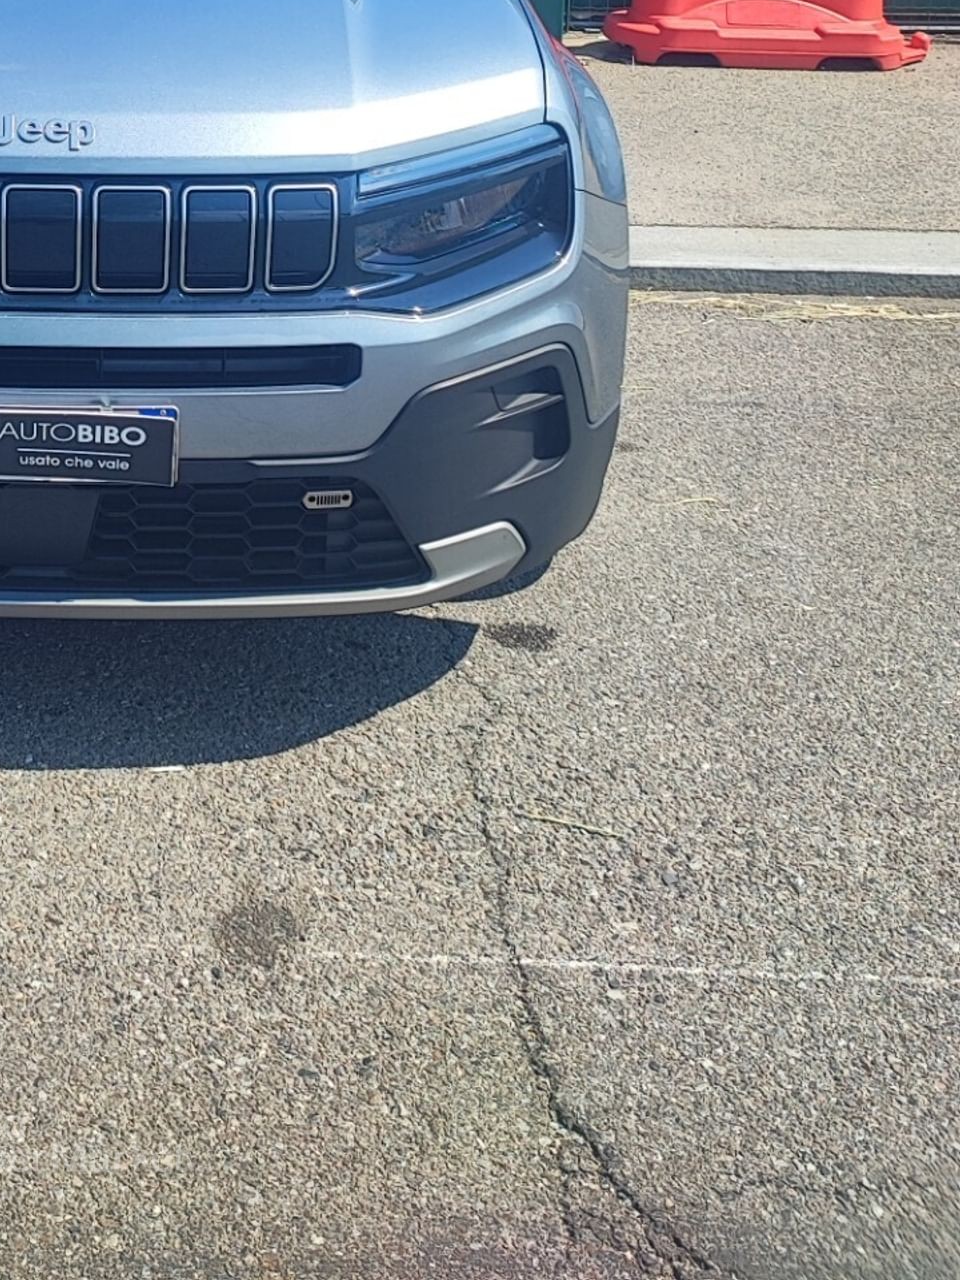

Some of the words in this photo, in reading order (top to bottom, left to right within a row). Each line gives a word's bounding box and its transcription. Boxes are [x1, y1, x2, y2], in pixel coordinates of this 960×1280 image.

[19, 455, 61, 466] usato
[64, 456, 94, 468] che
[97, 458, 130, 470] vale
